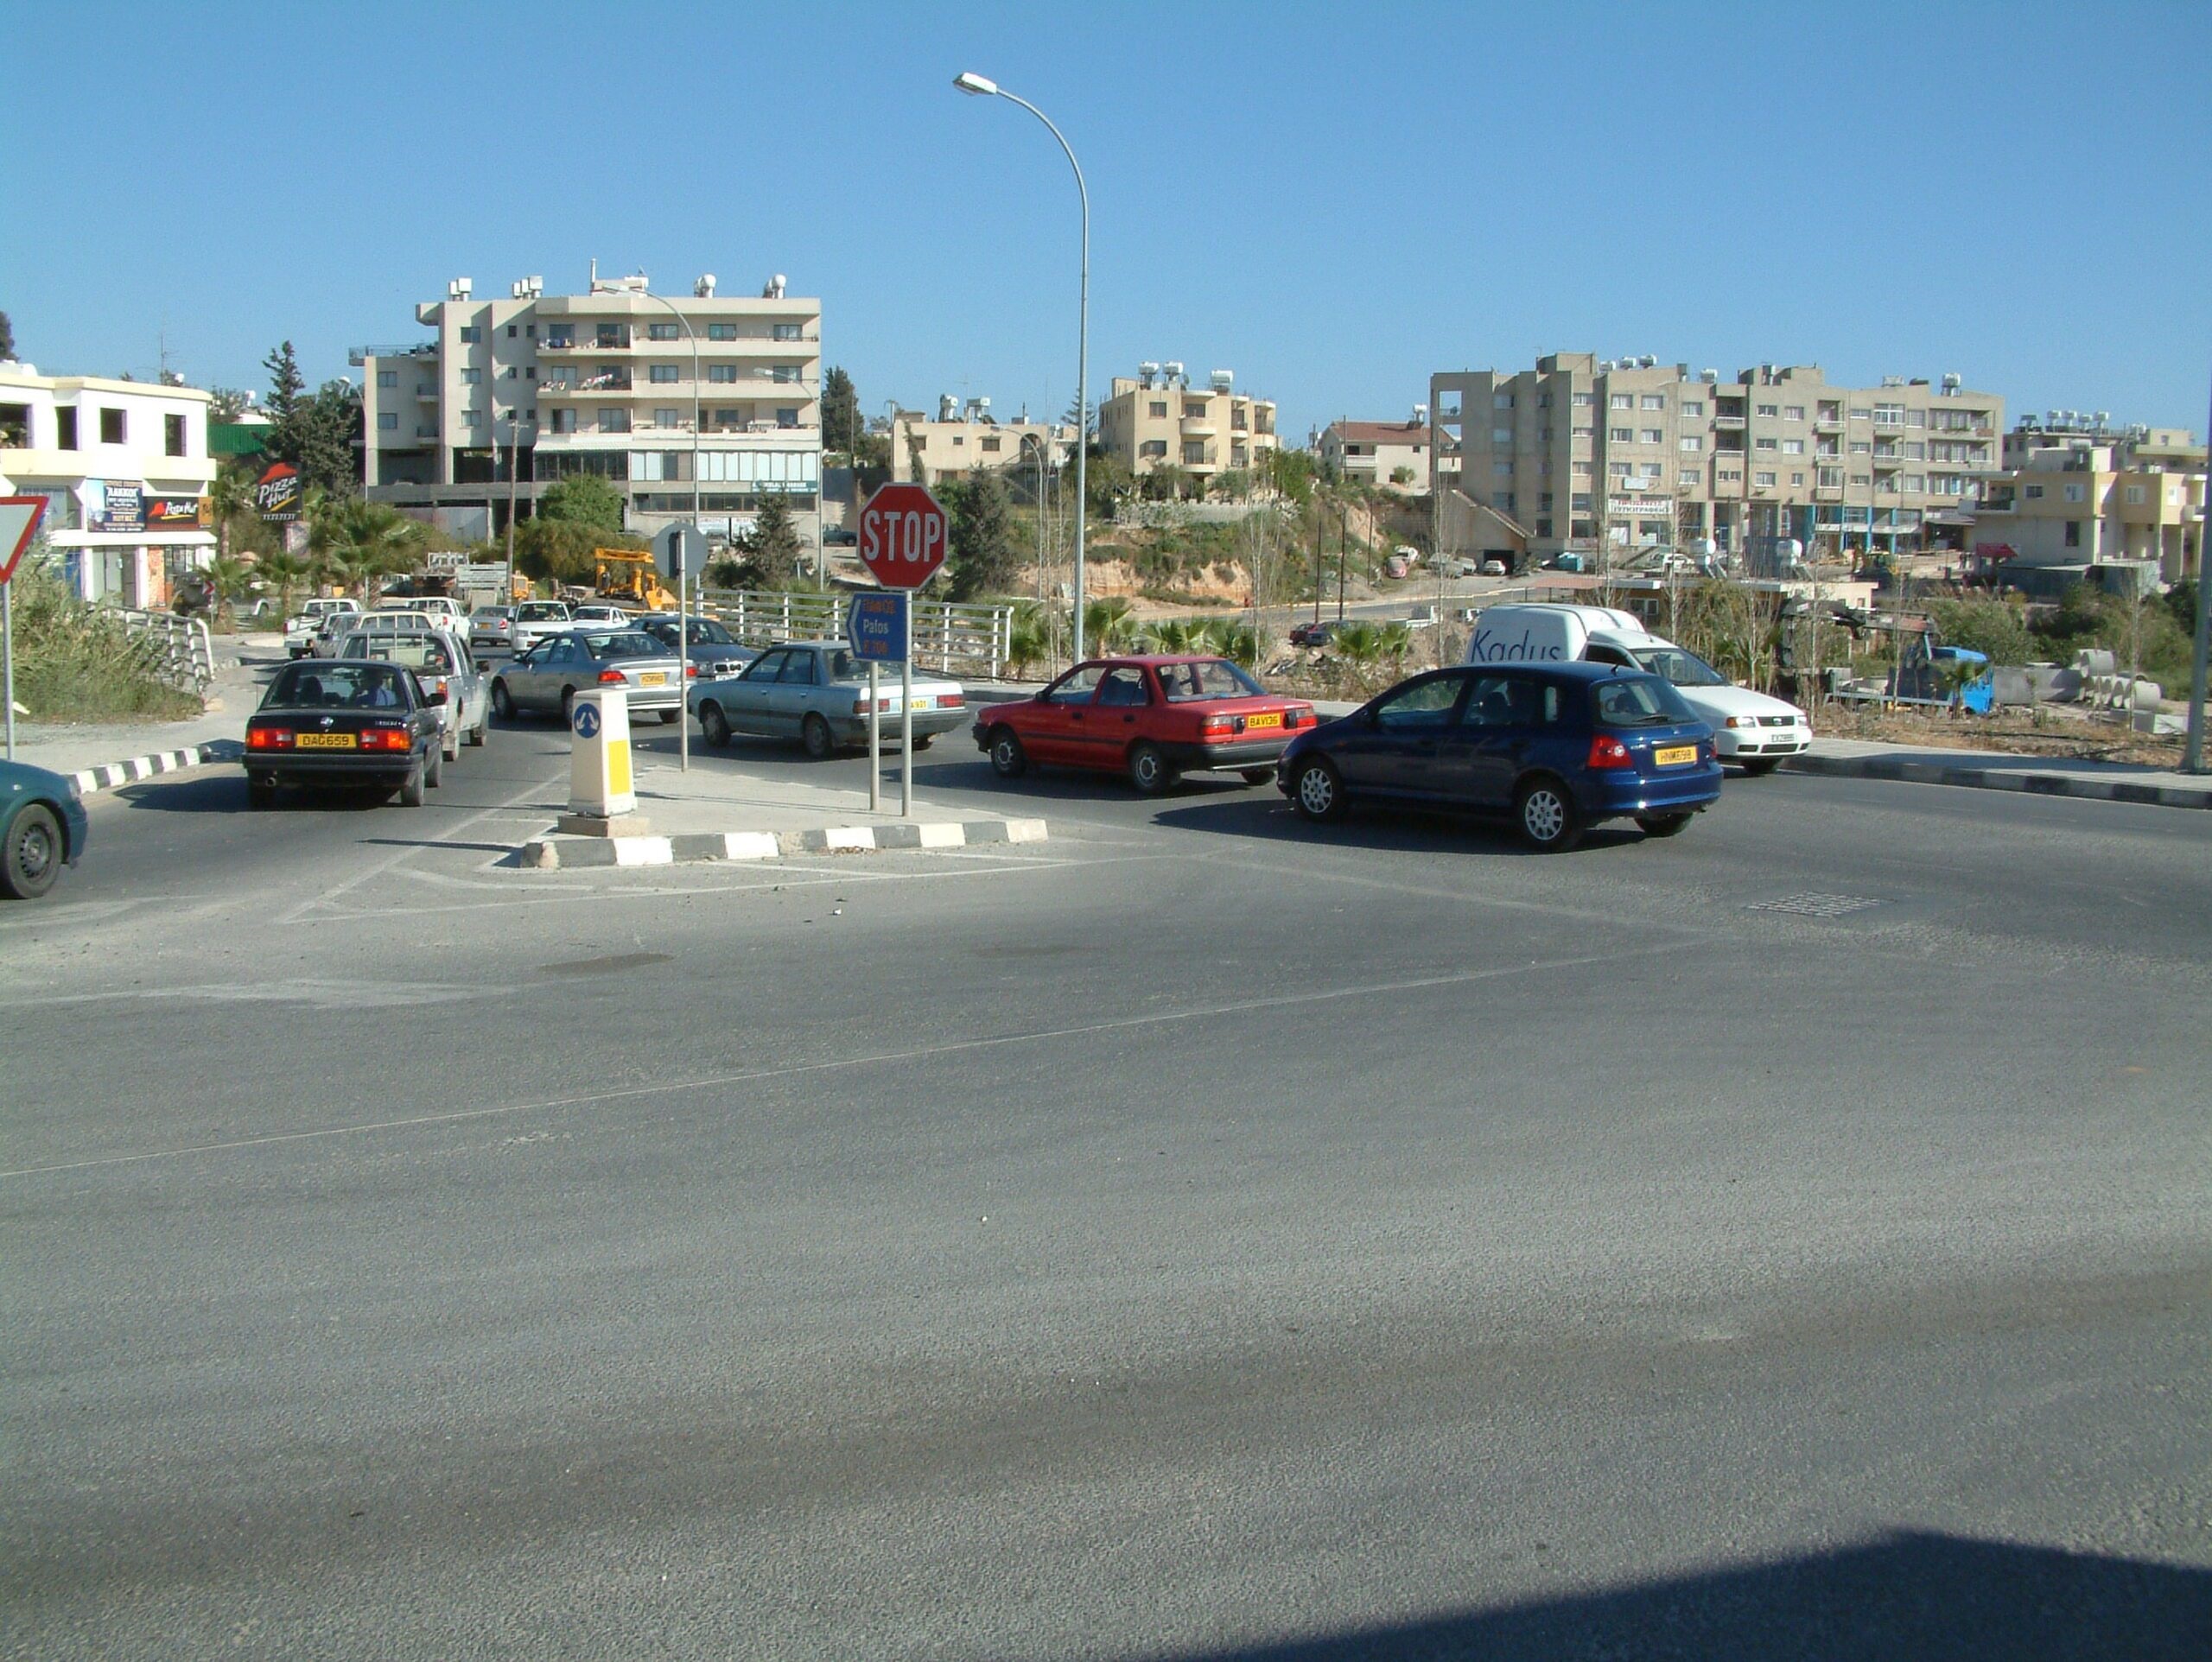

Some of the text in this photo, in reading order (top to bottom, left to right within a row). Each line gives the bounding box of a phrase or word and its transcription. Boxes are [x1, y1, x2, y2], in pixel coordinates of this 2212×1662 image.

[259, 477, 297, 504] Pizza
[266, 488, 295, 508] Hut
[864, 510, 940, 562] STOP
[1471, 630, 1561, 663] Kadus
